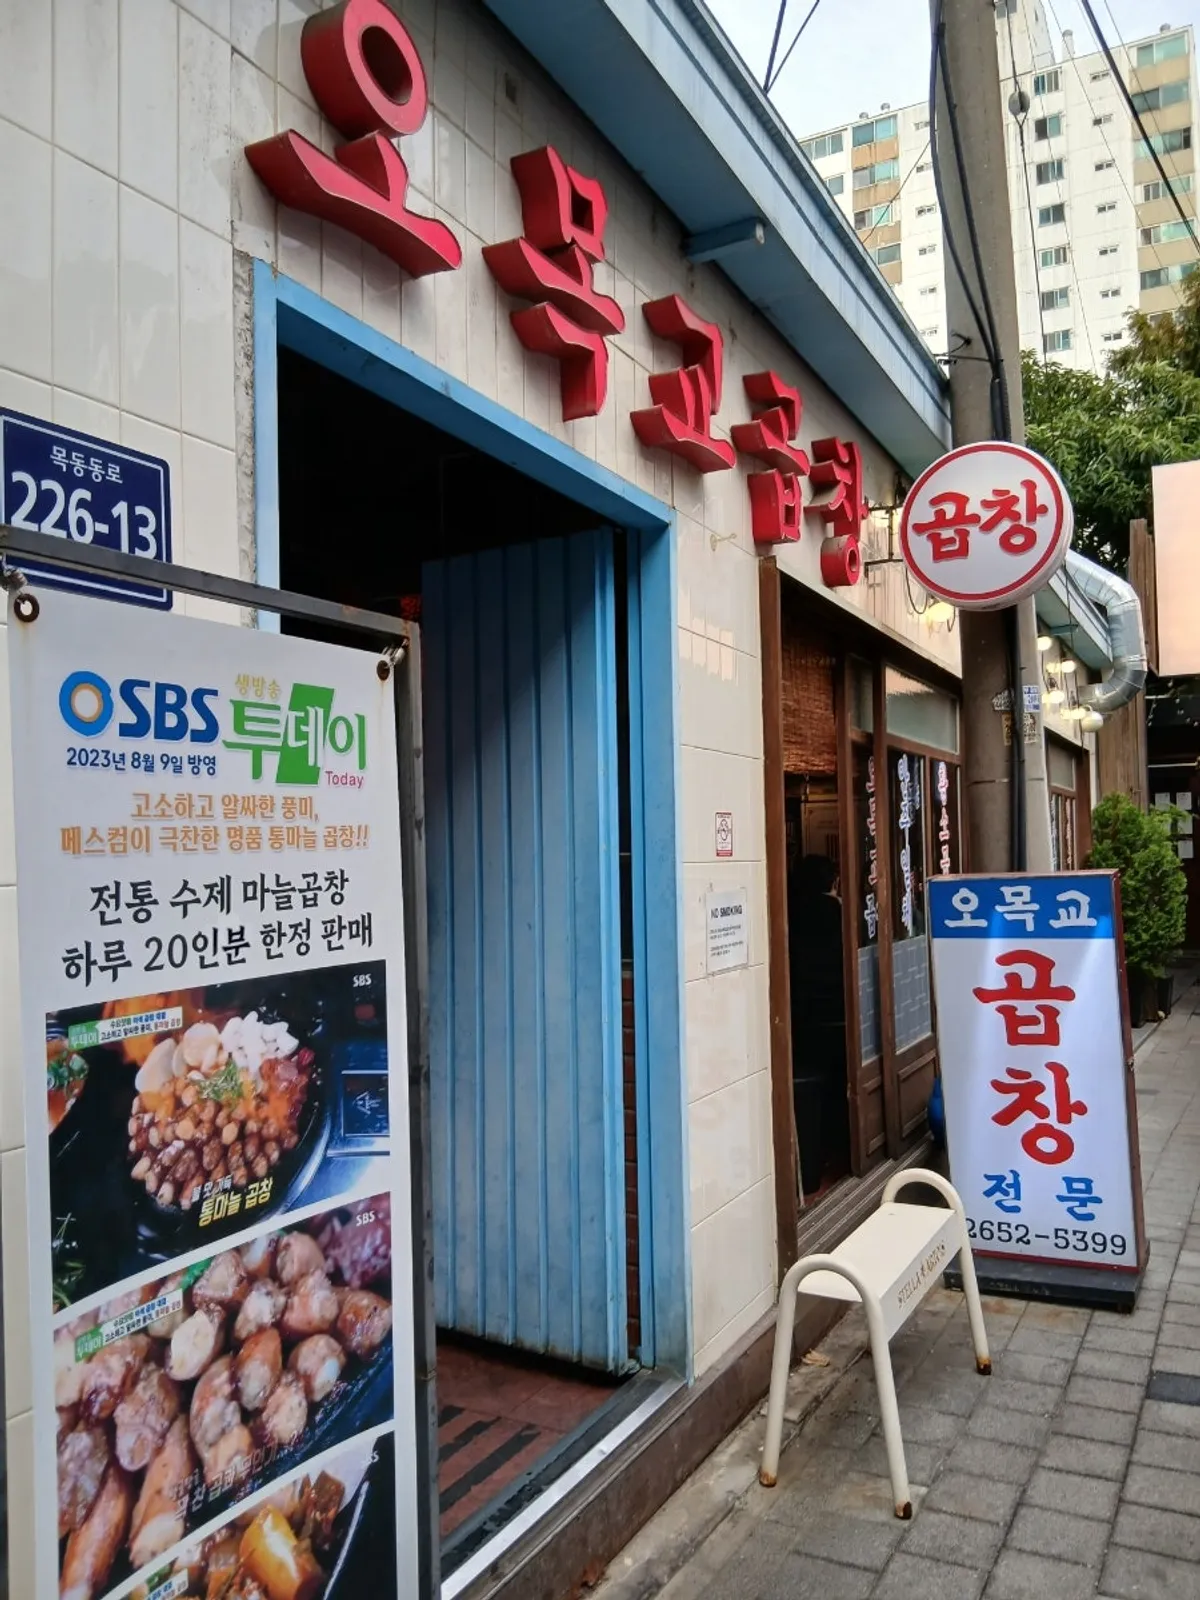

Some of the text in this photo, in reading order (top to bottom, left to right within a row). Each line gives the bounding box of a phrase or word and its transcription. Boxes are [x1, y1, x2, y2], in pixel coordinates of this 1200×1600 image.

[50, 445, 123, 484] 목동동로
[10, 471, 158, 560] 226-13
[912, 479, 1048, 563] 곱창
[235, 674, 281, 699] 생방송
[119, 679, 219, 743] SBS
[66, 747, 216, 776] 2023년 8월 9일 방영
[222, 698, 367, 781] 투데이
[325, 771, 364, 789] Today
[131, 792, 319, 822] 고소하고 알싸한 풍미,
[60, 825, 369, 855] 메스컴이 극찬한 명품 통마늘 곱창!!
[90, 868, 349, 926] 전통 수제 마늘곱창
[943, 885, 1098, 932] 오목교
[61, 912, 373, 987] 하루 20인분 한정 판매
[353, 973, 372, 988] SBS
[973, 948, 1088, 1165] 곱창
[199, 1191, 242, 1227] 통마늘
[244, 1176, 274, 1210] 곱창
[356, 1210, 375, 1227] SBS
[982, 1169, 1103, 1222] 전문
[966, 1217, 1127, 1256] 2652-5399
